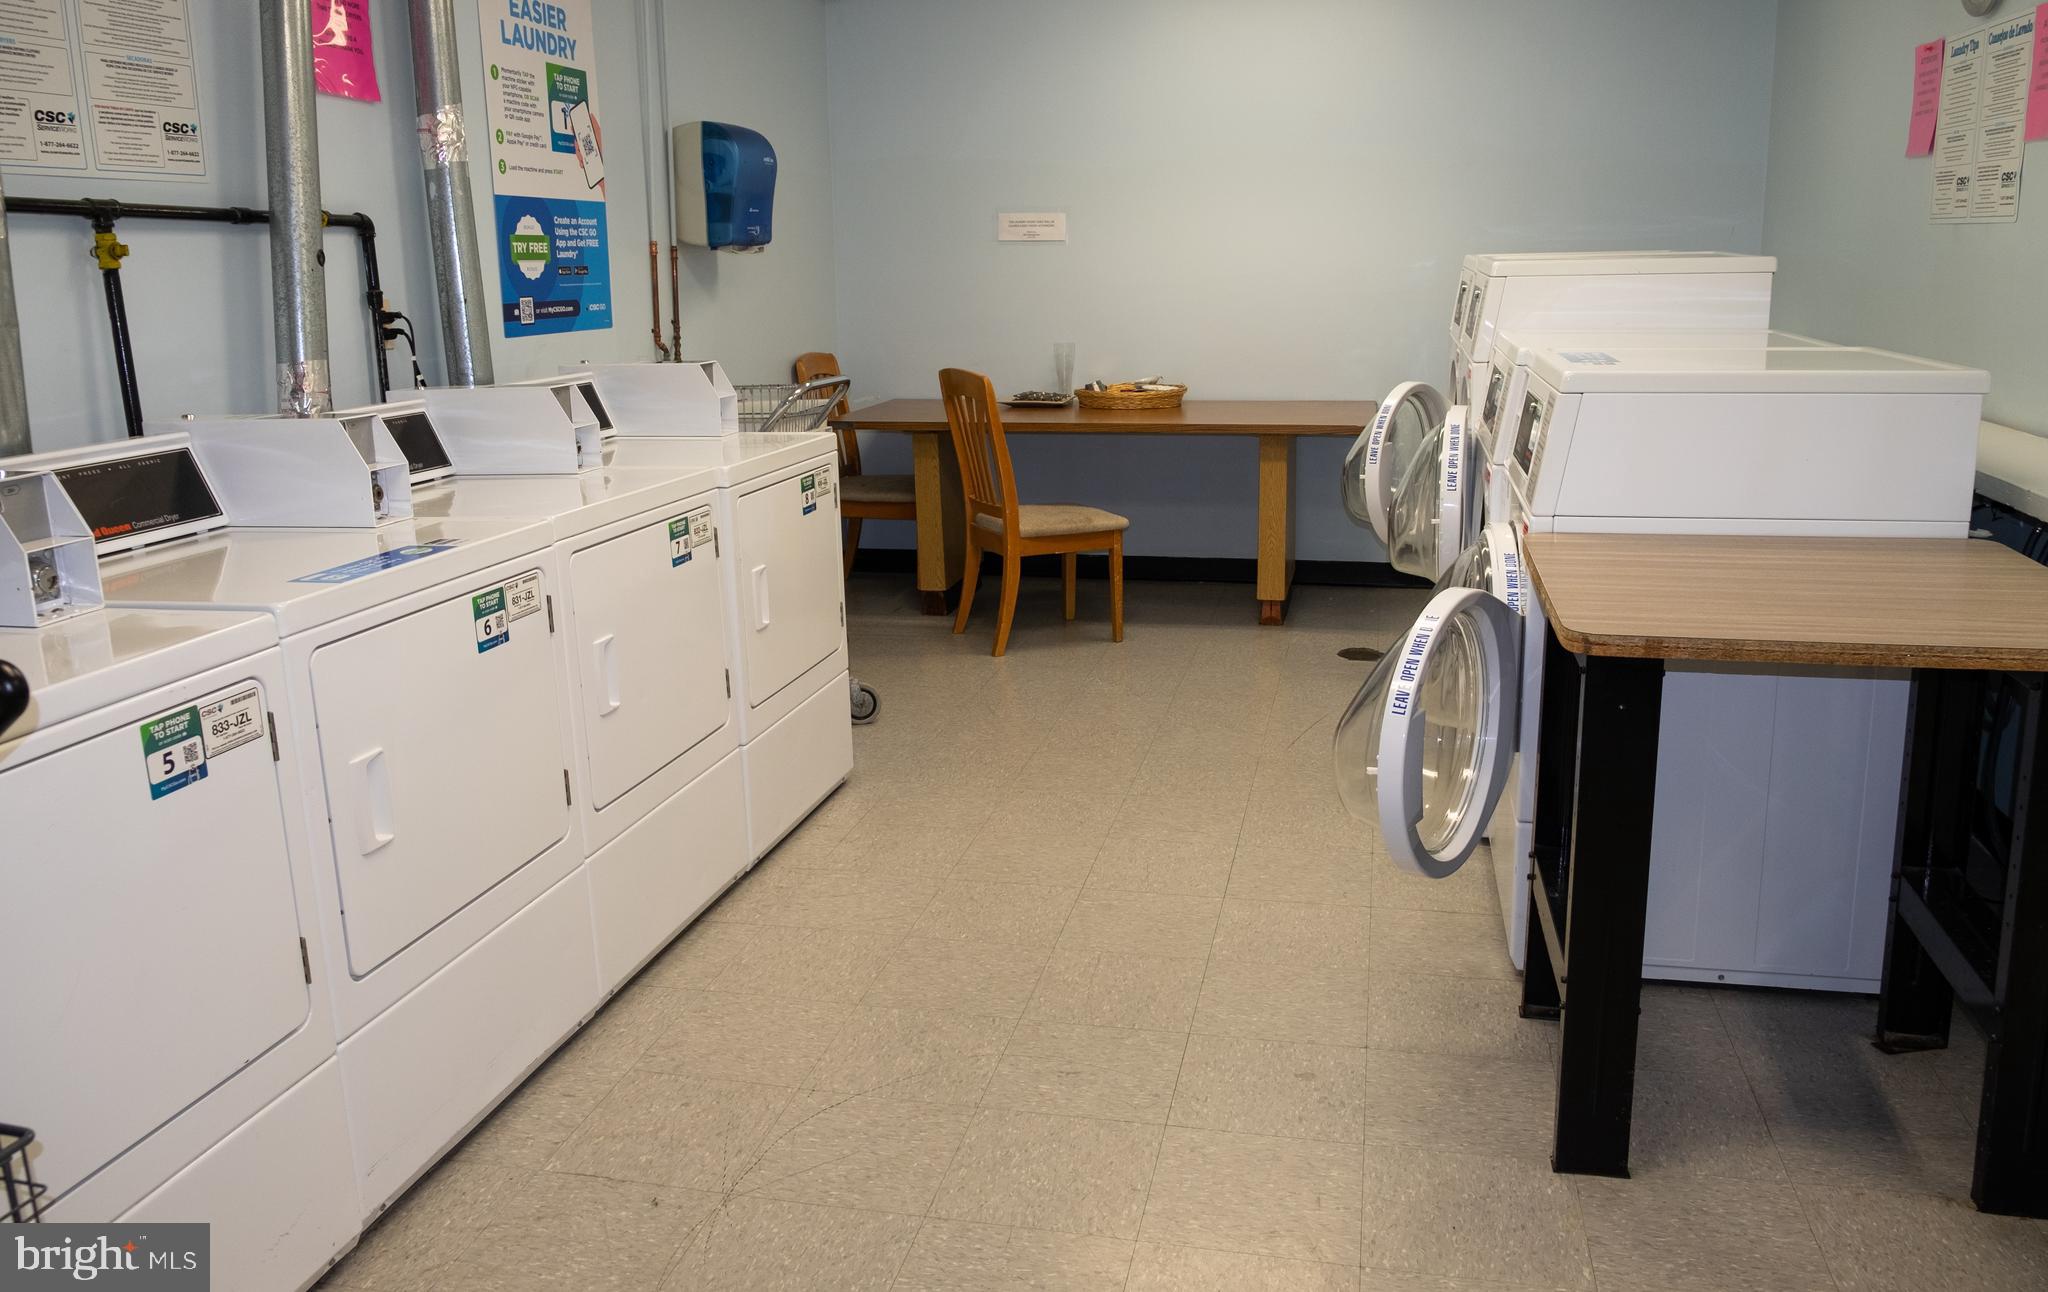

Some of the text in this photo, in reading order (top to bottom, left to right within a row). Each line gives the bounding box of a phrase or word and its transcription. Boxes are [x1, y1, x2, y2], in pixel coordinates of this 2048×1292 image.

[508, 0, 567, 31] EASIER
[500, 20, 576, 61] LAUNDRY
[1950, 42, 1970, 59] Laundry
[554, 74, 580, 86] TAP PHONE
[556, 82, 579, 93] TO START
[35, 110, 66, 124] CSC
[163, 122, 189, 134] CSC
[554, 216, 570, 225] Create
[578, 218, 597, 226] Account
[555, 227, 597, 237] Using the CSC GO
[512, 242, 548, 253] TRY FREE
[556, 239, 567, 248] App
[1369, 404, 1392, 465] LEAVE OPEN WHEN DONE
[1447, 424, 1460, 492] LEAVE OPEN WHEN DONE
[102, 523, 132, 536] Queen
[132, 516, 164, 529] Commercial
[164, 514, 180, 523] Dryer
[676, 541, 680, 554] 7
[1504, 553, 1520, 612] OPEN WHEN DONE
[486, 598, 499, 608] START
[512, 590, 535, 606] 831-JZL
[484, 618, 492, 636] 6
[1409, 633, 1431, 656] WHEN
[1400, 658, 1420, 682] OPEN
[1392, 684, 1411, 716] LEAV
[201, 707, 217, 718] CSC
[149, 712, 191, 734] TAP PHONE
[153, 731, 165, 740] TO
[165, 721, 189, 736] START
[212, 711, 252, 736] 833-JZL
[163, 751, 175, 776] 5
